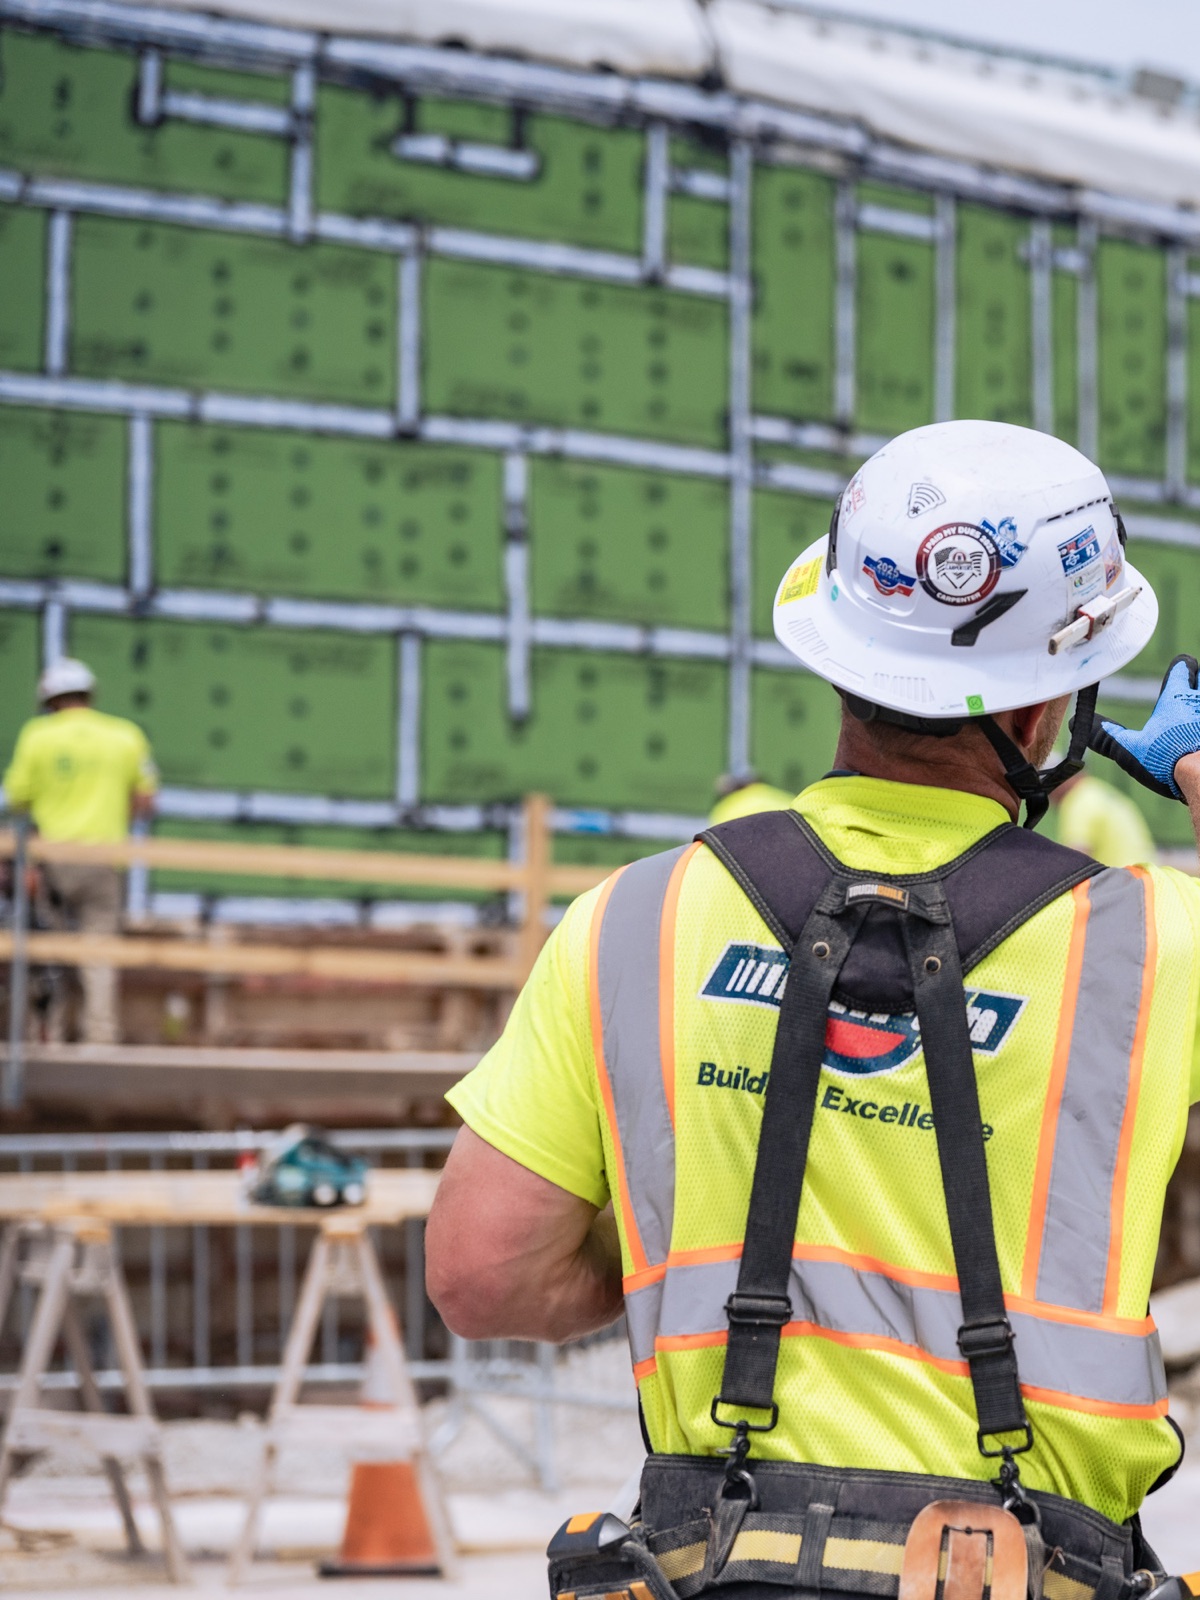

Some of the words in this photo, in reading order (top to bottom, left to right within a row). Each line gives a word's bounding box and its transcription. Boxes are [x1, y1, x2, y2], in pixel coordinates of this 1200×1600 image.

[925, 533, 944, 551] PAID
[943, 526, 958, 540] MY
[958, 526, 981, 539] DUES
[936, 592, 982, 604] CARPENTER
[697, 1061, 768, 1097] Build
[821, 1085, 995, 1142] Excellee
